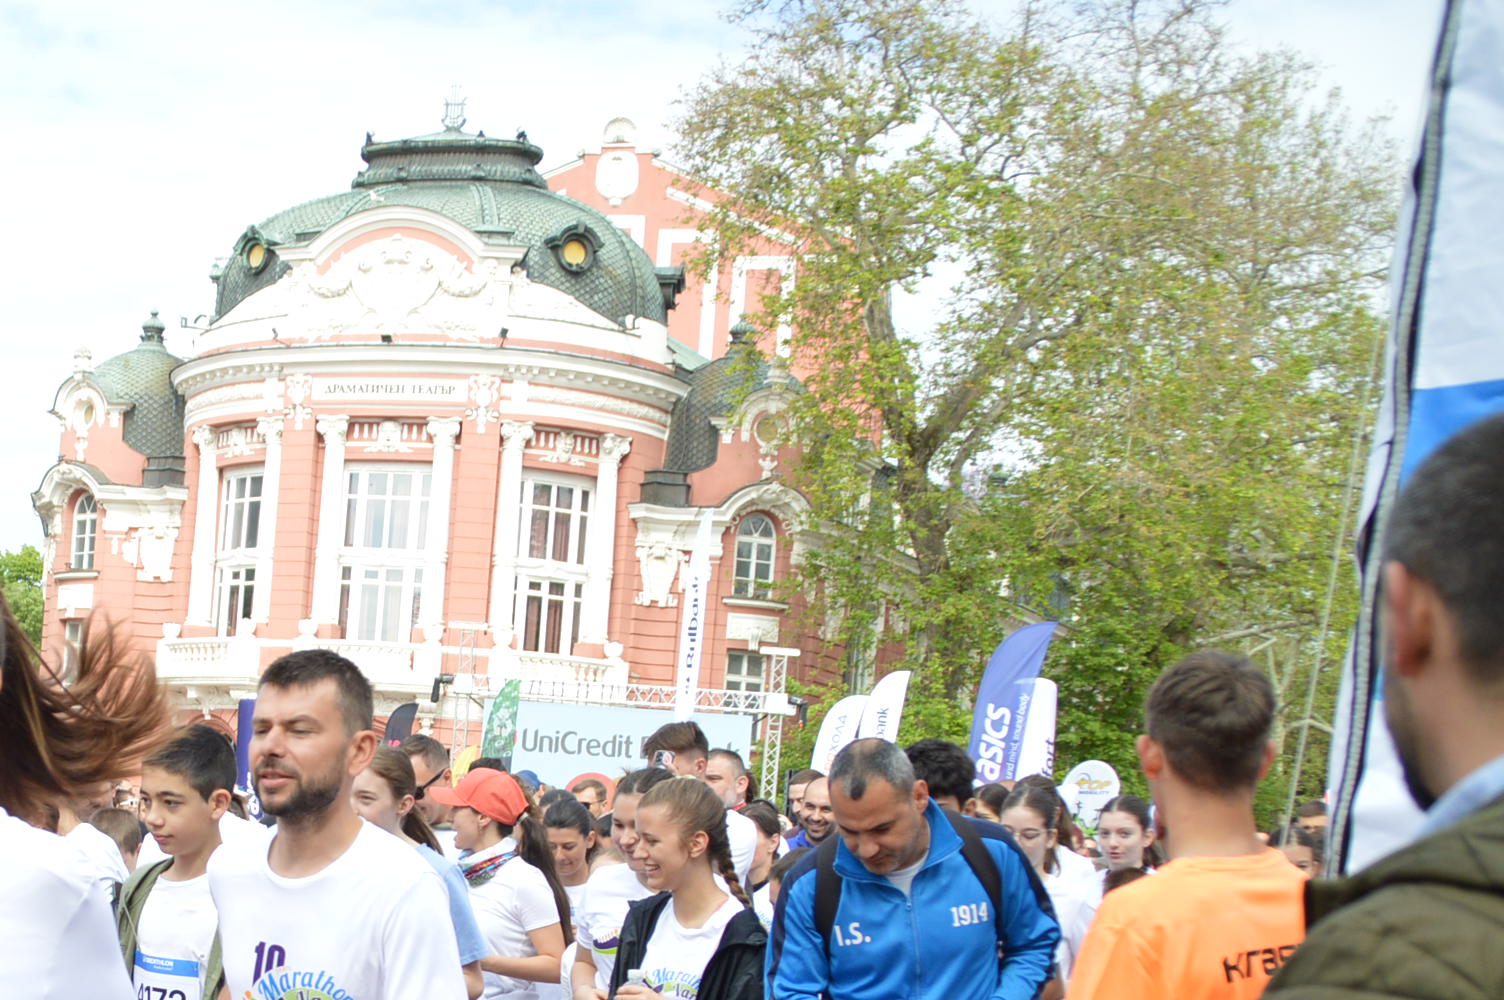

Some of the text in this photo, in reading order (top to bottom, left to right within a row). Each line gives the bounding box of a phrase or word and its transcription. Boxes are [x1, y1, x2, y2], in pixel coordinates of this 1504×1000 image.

[324, 384, 456, 395] ДРАМАТИЧЕН ТЕАТЪР
[521, 728, 633, 758] UniCredit
[976, 703, 1012, 781] asics
[950, 902, 989, 927] 1914
[834, 922, 872, 946] I.S.
[252, 941, 286, 987] 10
